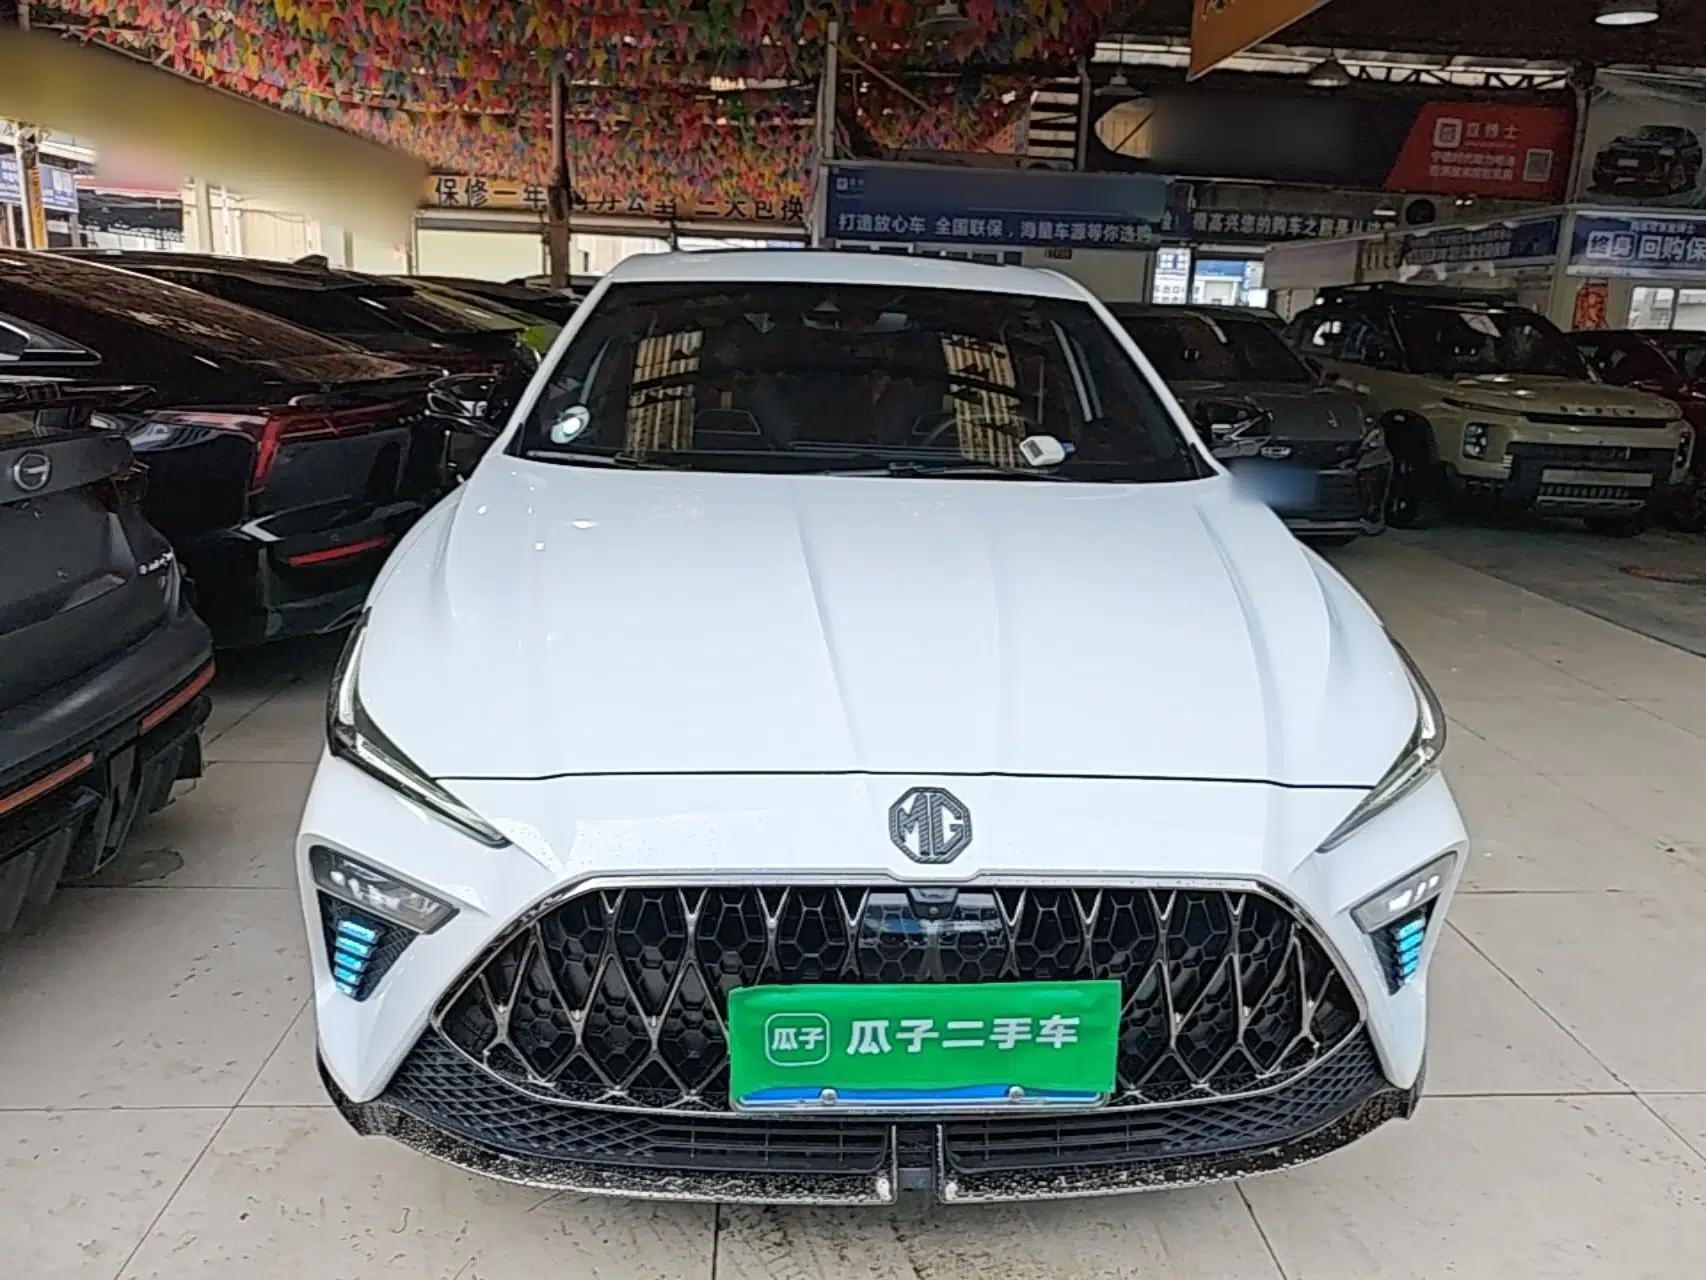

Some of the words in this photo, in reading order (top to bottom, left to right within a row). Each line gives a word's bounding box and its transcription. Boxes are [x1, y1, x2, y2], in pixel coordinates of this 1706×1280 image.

[435, 176, 547, 209] 保修一年
[838, 212, 926, 236] 打造放心车
[895, 790, 967, 859] MG
[771, 1026, 825, 1051] 瓜子
[846, 1014, 1081, 1055] 瓜子二手车
